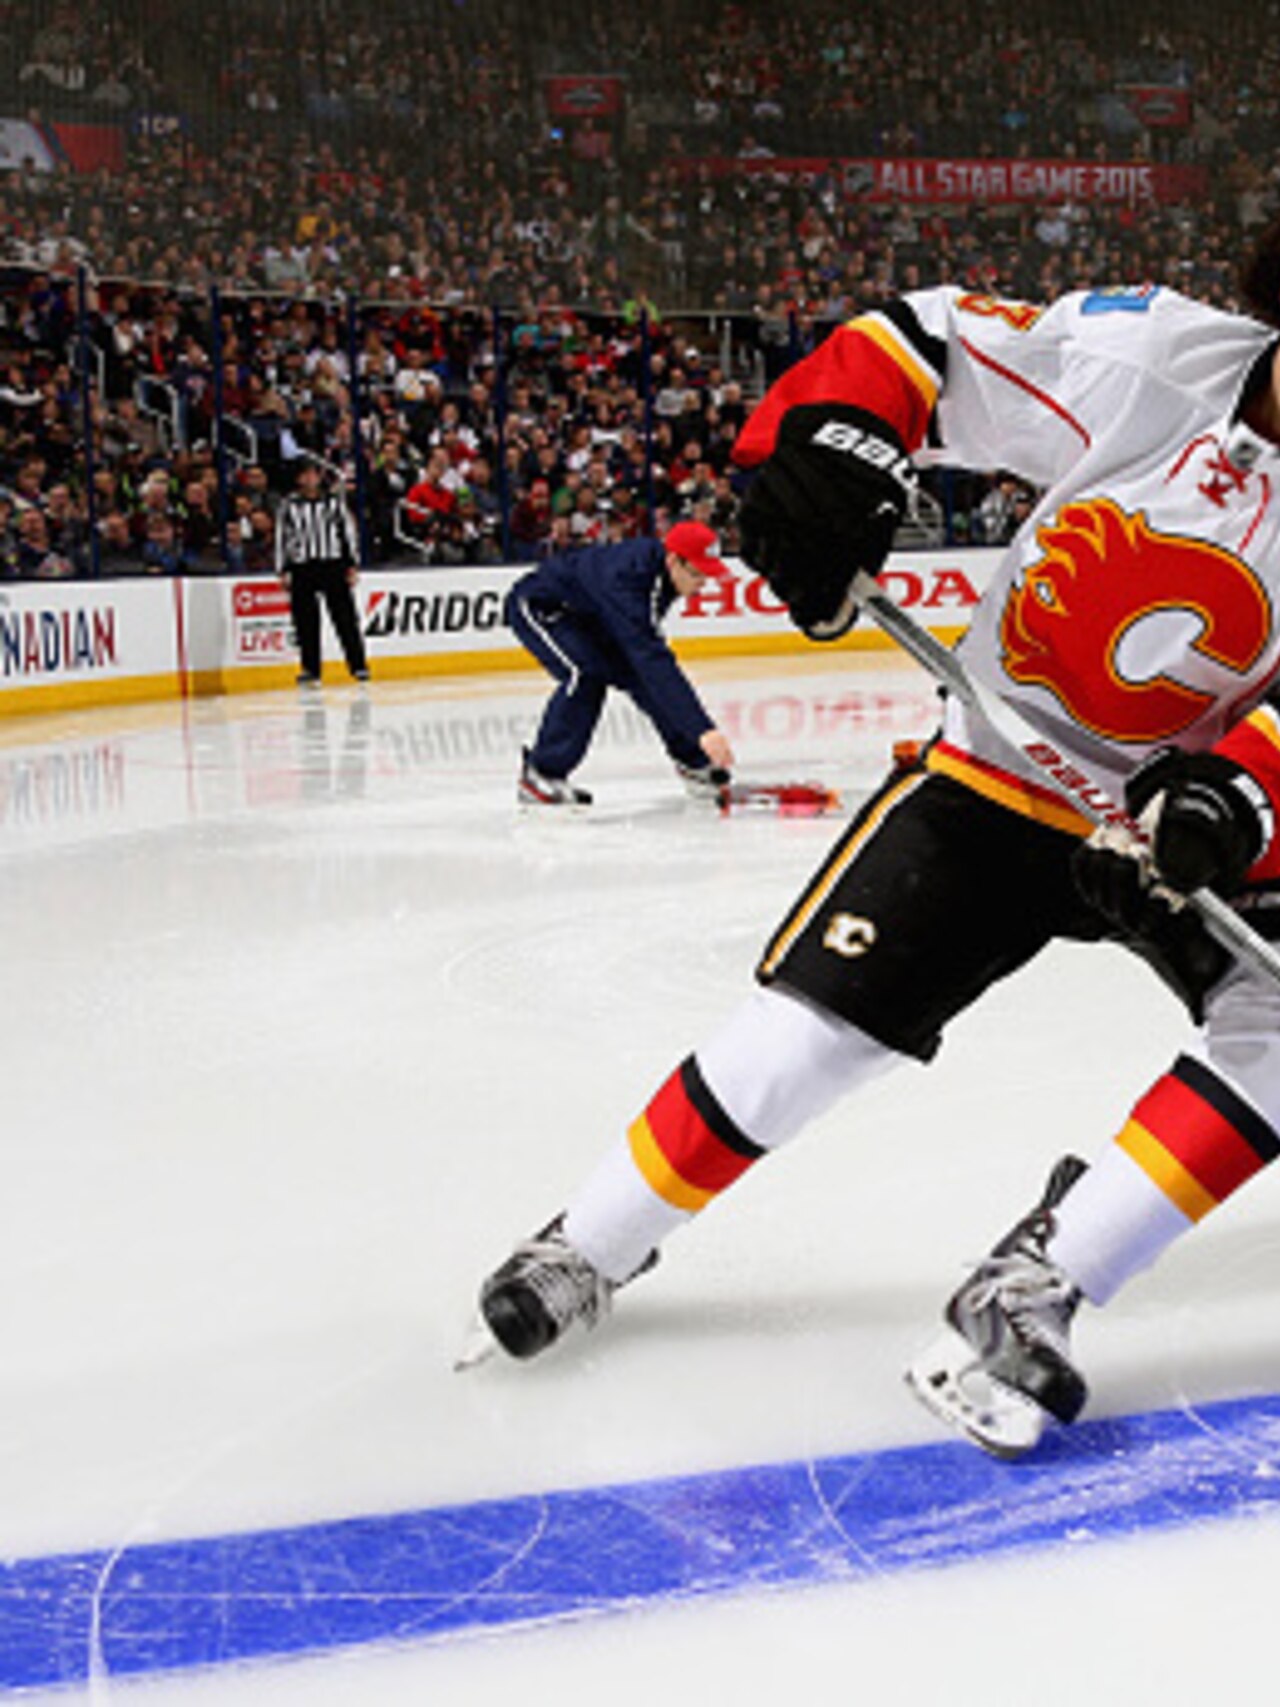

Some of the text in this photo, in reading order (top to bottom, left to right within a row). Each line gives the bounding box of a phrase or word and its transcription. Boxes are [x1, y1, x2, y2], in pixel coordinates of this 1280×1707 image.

[881, 161, 1151, 199] ALL STAR GAME 2015
[241, 630, 284, 653] LIVE
